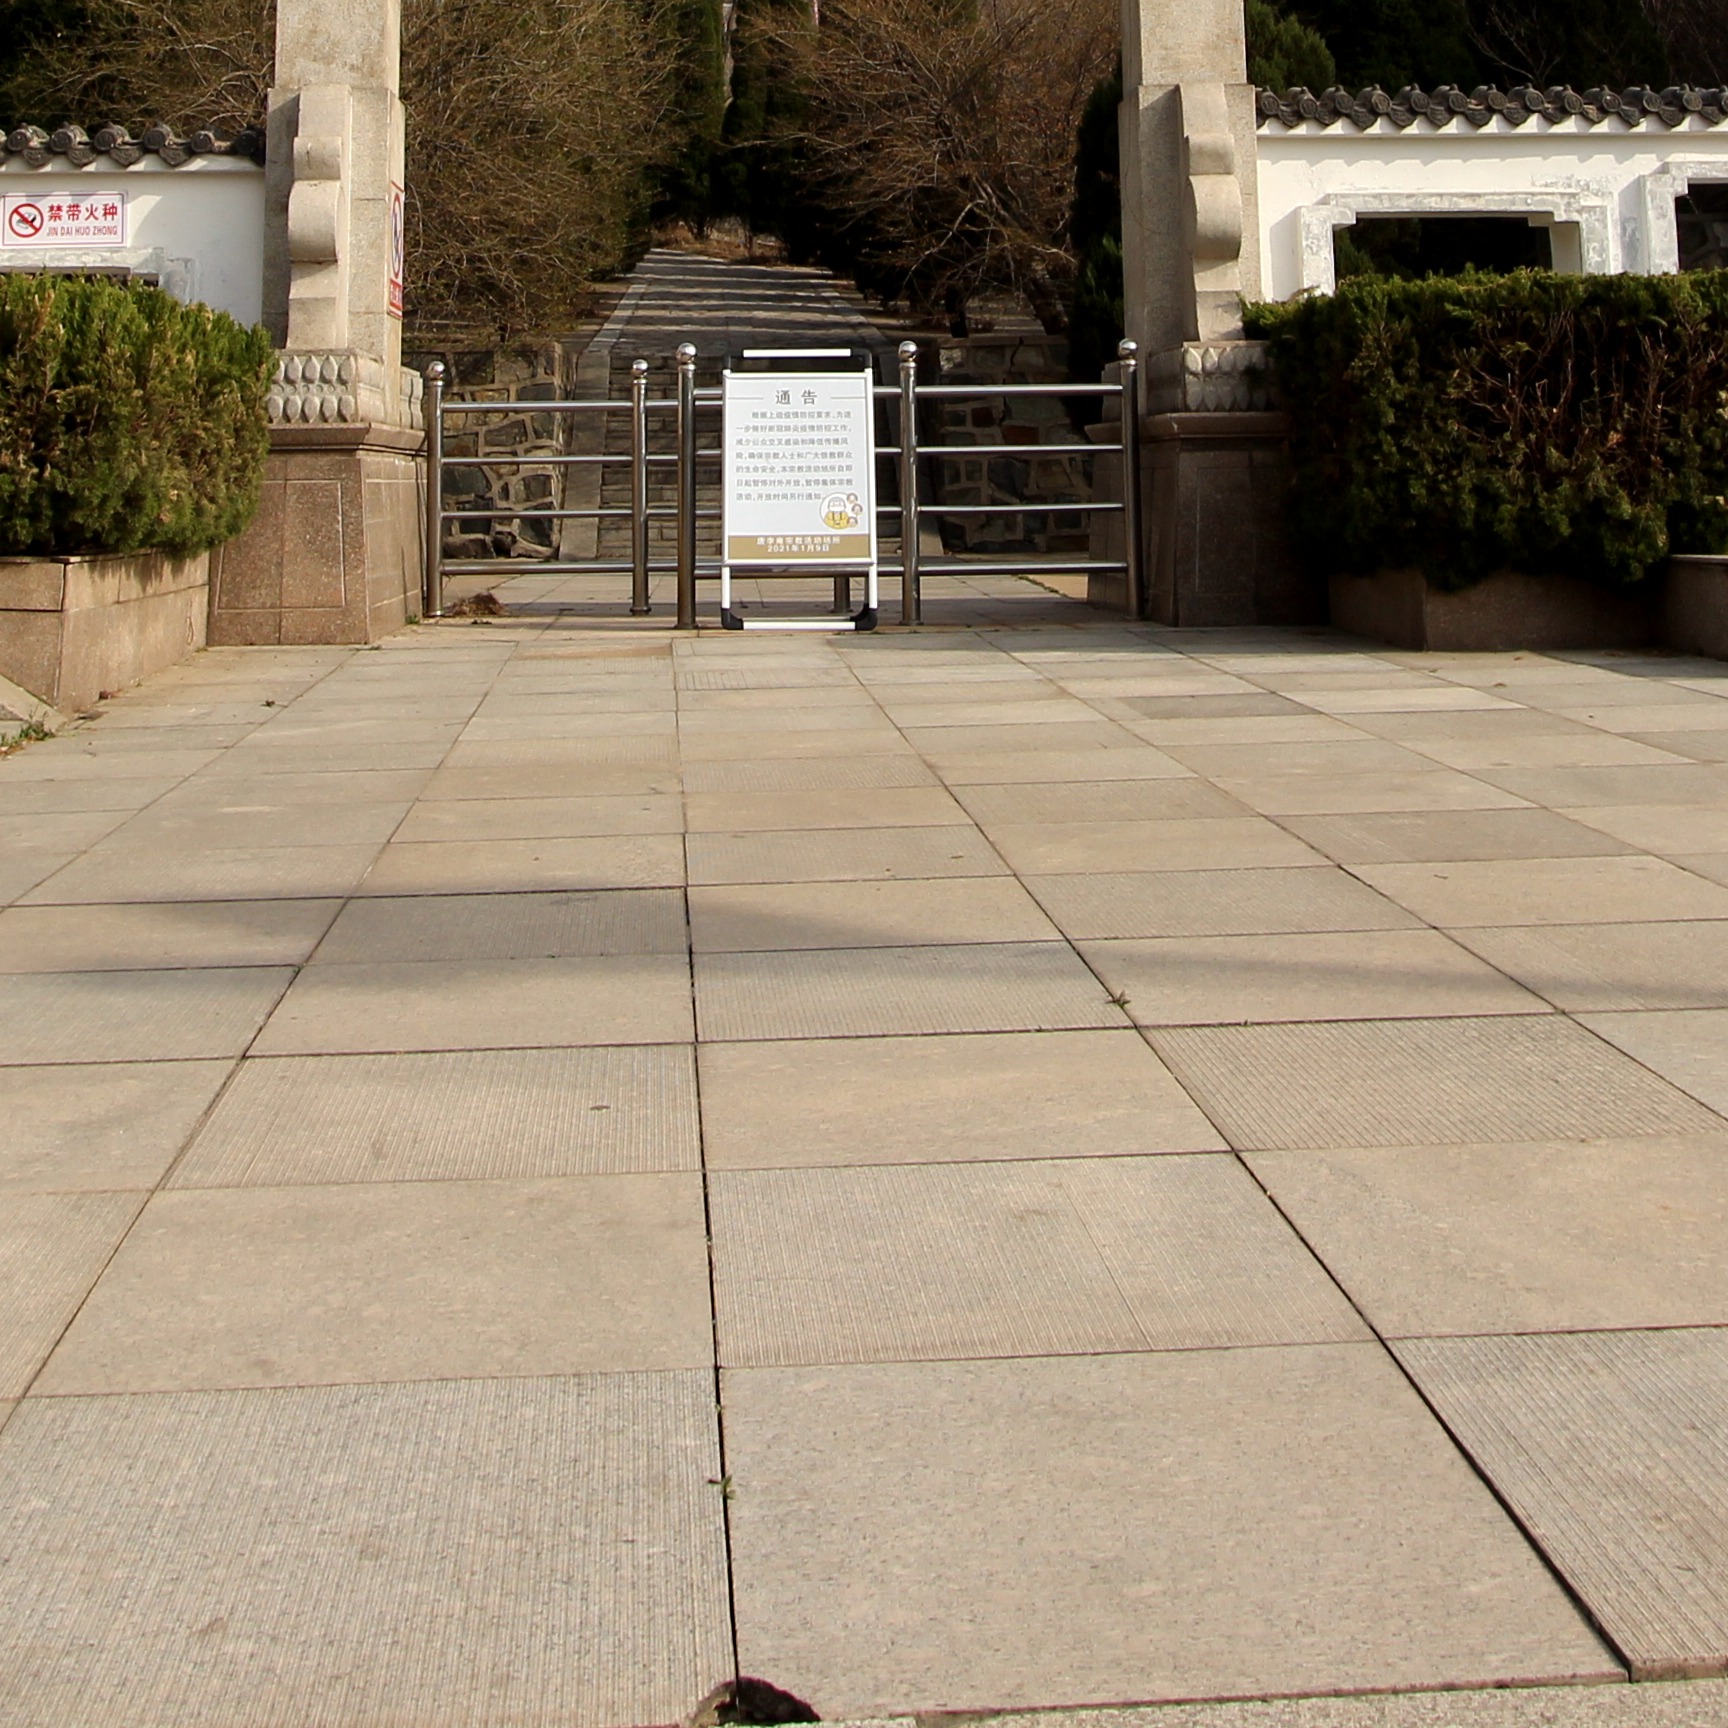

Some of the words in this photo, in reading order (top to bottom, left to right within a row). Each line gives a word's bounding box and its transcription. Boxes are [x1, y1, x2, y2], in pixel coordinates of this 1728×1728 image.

[47, 202, 119, 222] 禁带火种
[47, 225, 59, 237] JIN
[60, 225, 73, 237] DAI
[75, 225, 91, 236] HUO
[92, 225, 118, 236] ZHONG
[775, 389, 818, 406] 通告
